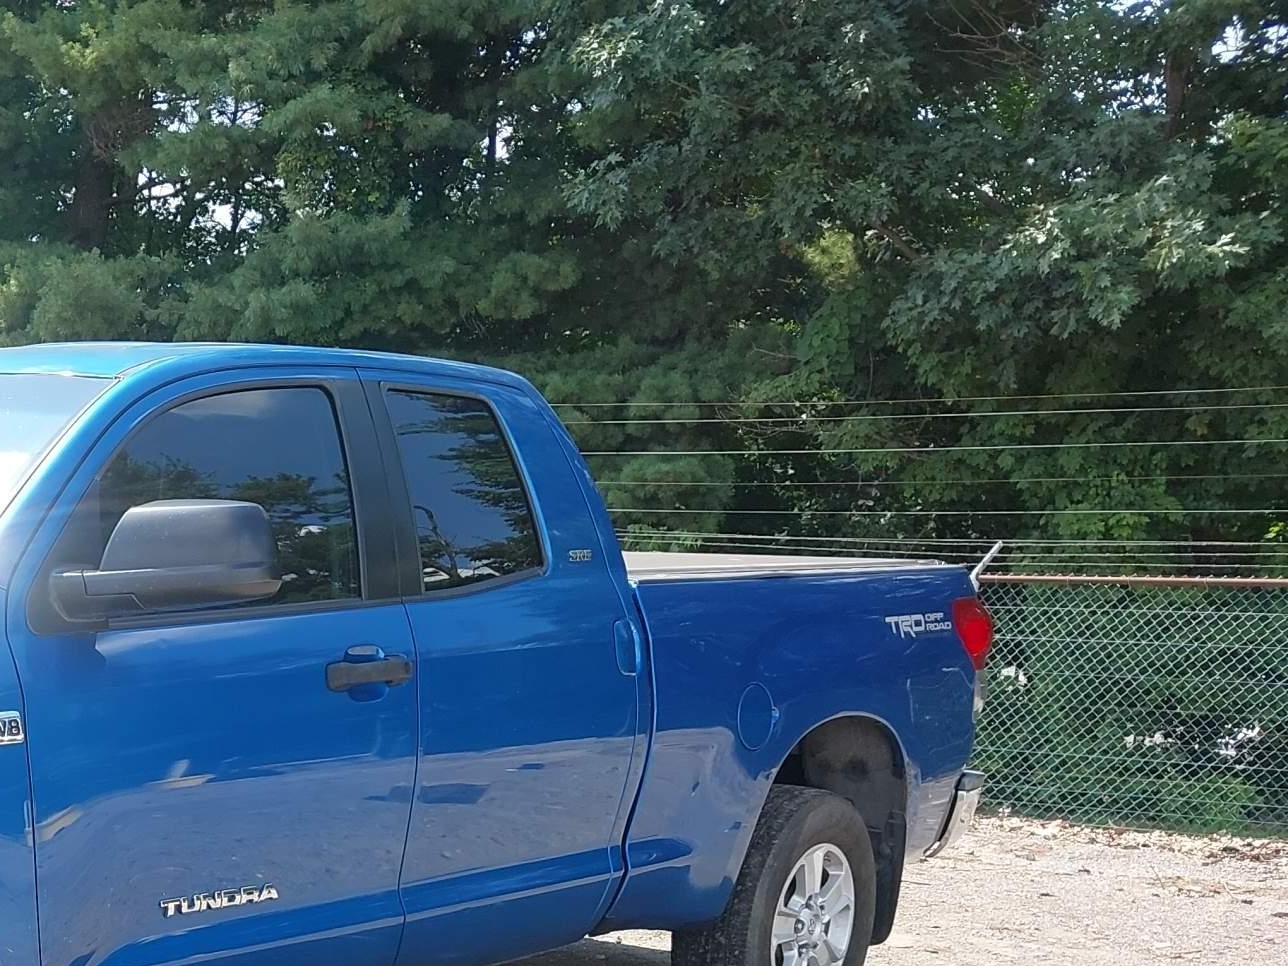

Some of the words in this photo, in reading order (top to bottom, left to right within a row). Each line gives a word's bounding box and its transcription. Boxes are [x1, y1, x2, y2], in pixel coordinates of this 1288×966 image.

[925, 612, 944, 621] OFF
[885, 614, 925, 638] TRD
[926, 621, 952, 631] ROAD
[160, 883, 279, 918] TUNDRA
